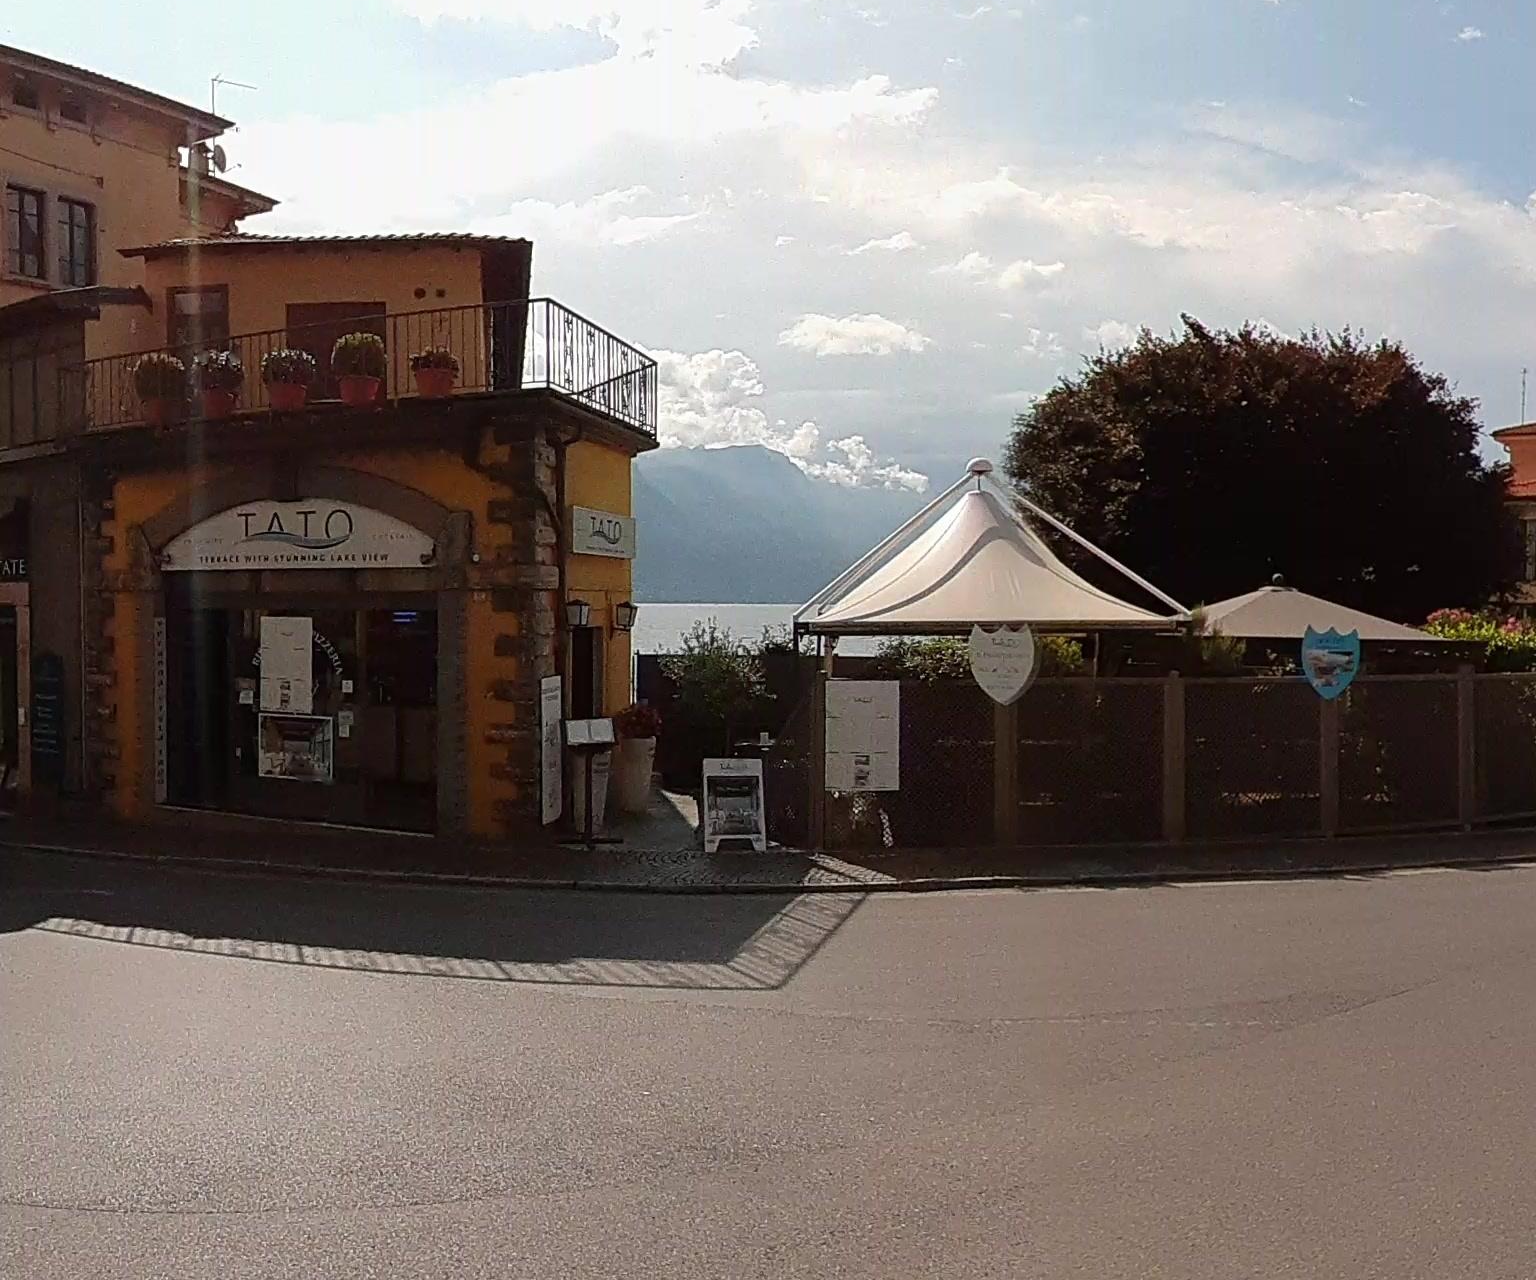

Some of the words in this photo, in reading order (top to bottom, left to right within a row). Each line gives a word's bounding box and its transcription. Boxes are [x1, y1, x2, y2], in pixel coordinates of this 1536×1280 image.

[237, 509, 353, 539] TATO
[590, 516, 621, 541] TATO
[199, 555, 240, 563] TERRACE
[244, 554, 269, 563] WITH
[273, 553, 326, 562] STUNNING
[330, 553, 357, 562] LAKE
[361, 553, 389, 562] VIEW
